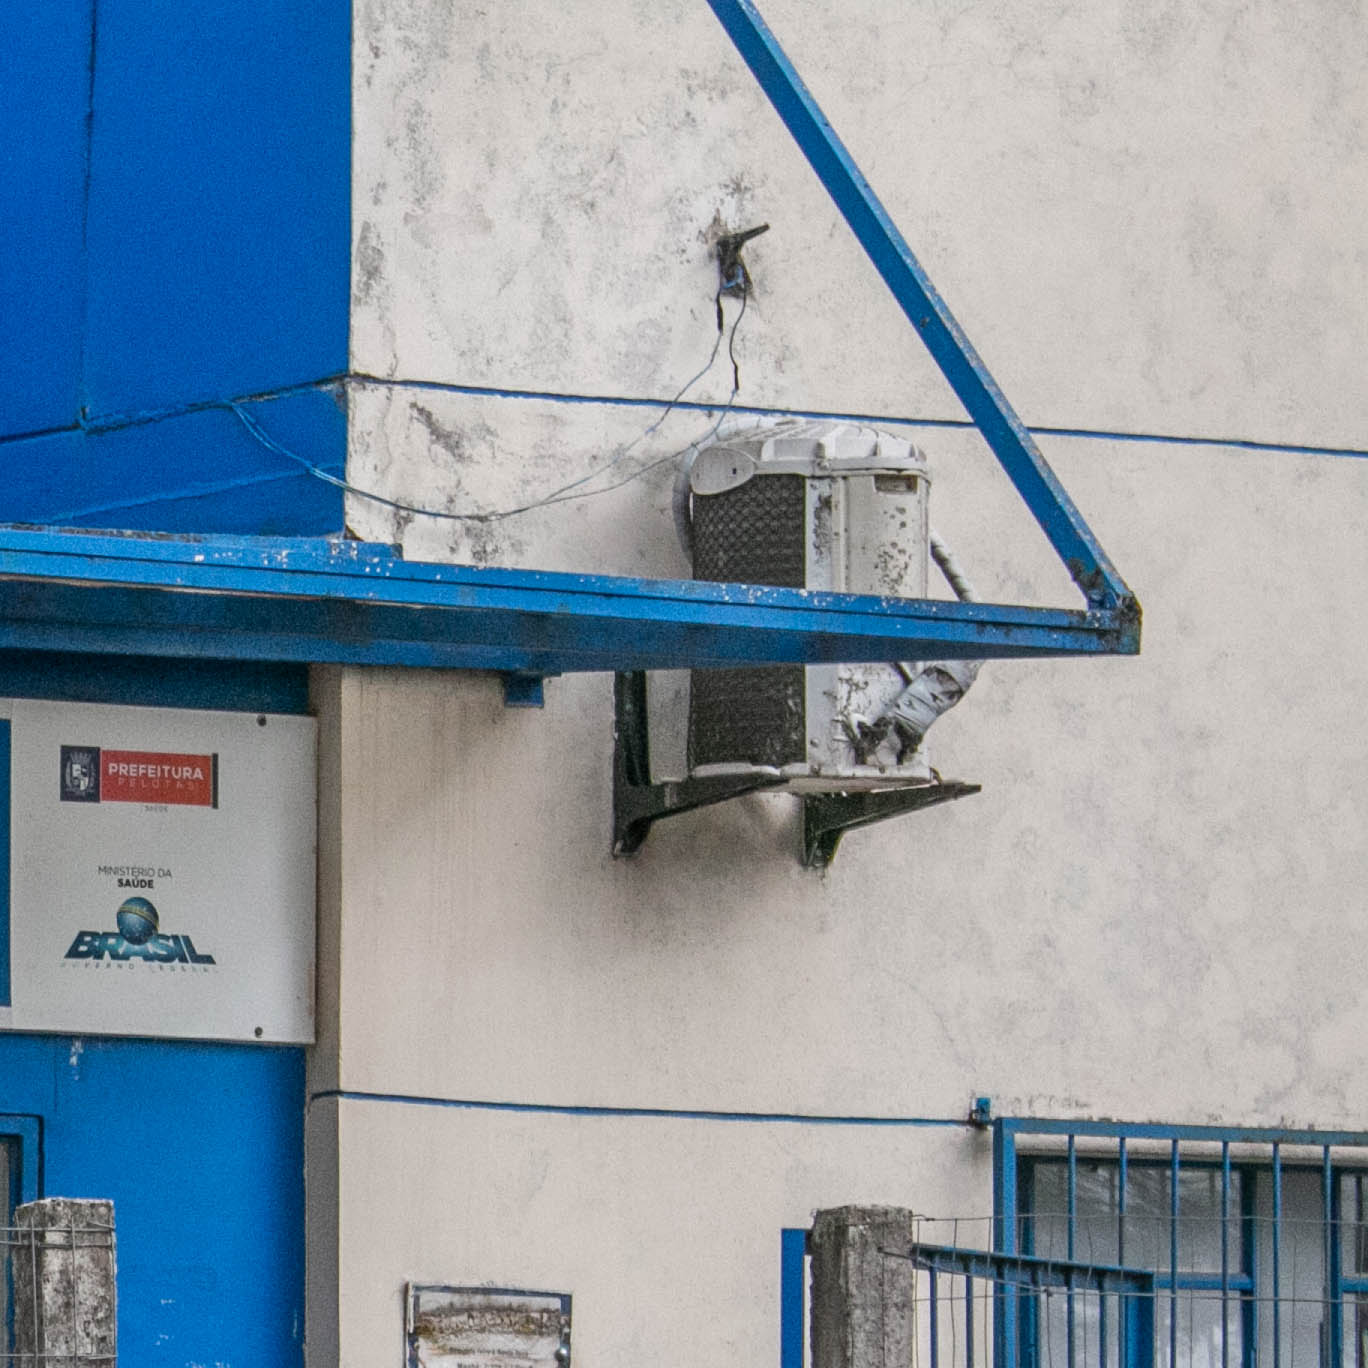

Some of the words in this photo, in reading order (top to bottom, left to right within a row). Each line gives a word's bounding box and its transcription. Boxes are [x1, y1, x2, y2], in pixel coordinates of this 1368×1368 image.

[108, 762, 205, 781] PREFEITURA
[98, 865, 156, 878] MINISTÉRIO
[157, 868, 172, 879] DA
[117, 875, 155, 889] SAÚDE
[64, 930, 217, 965] BRASIL
